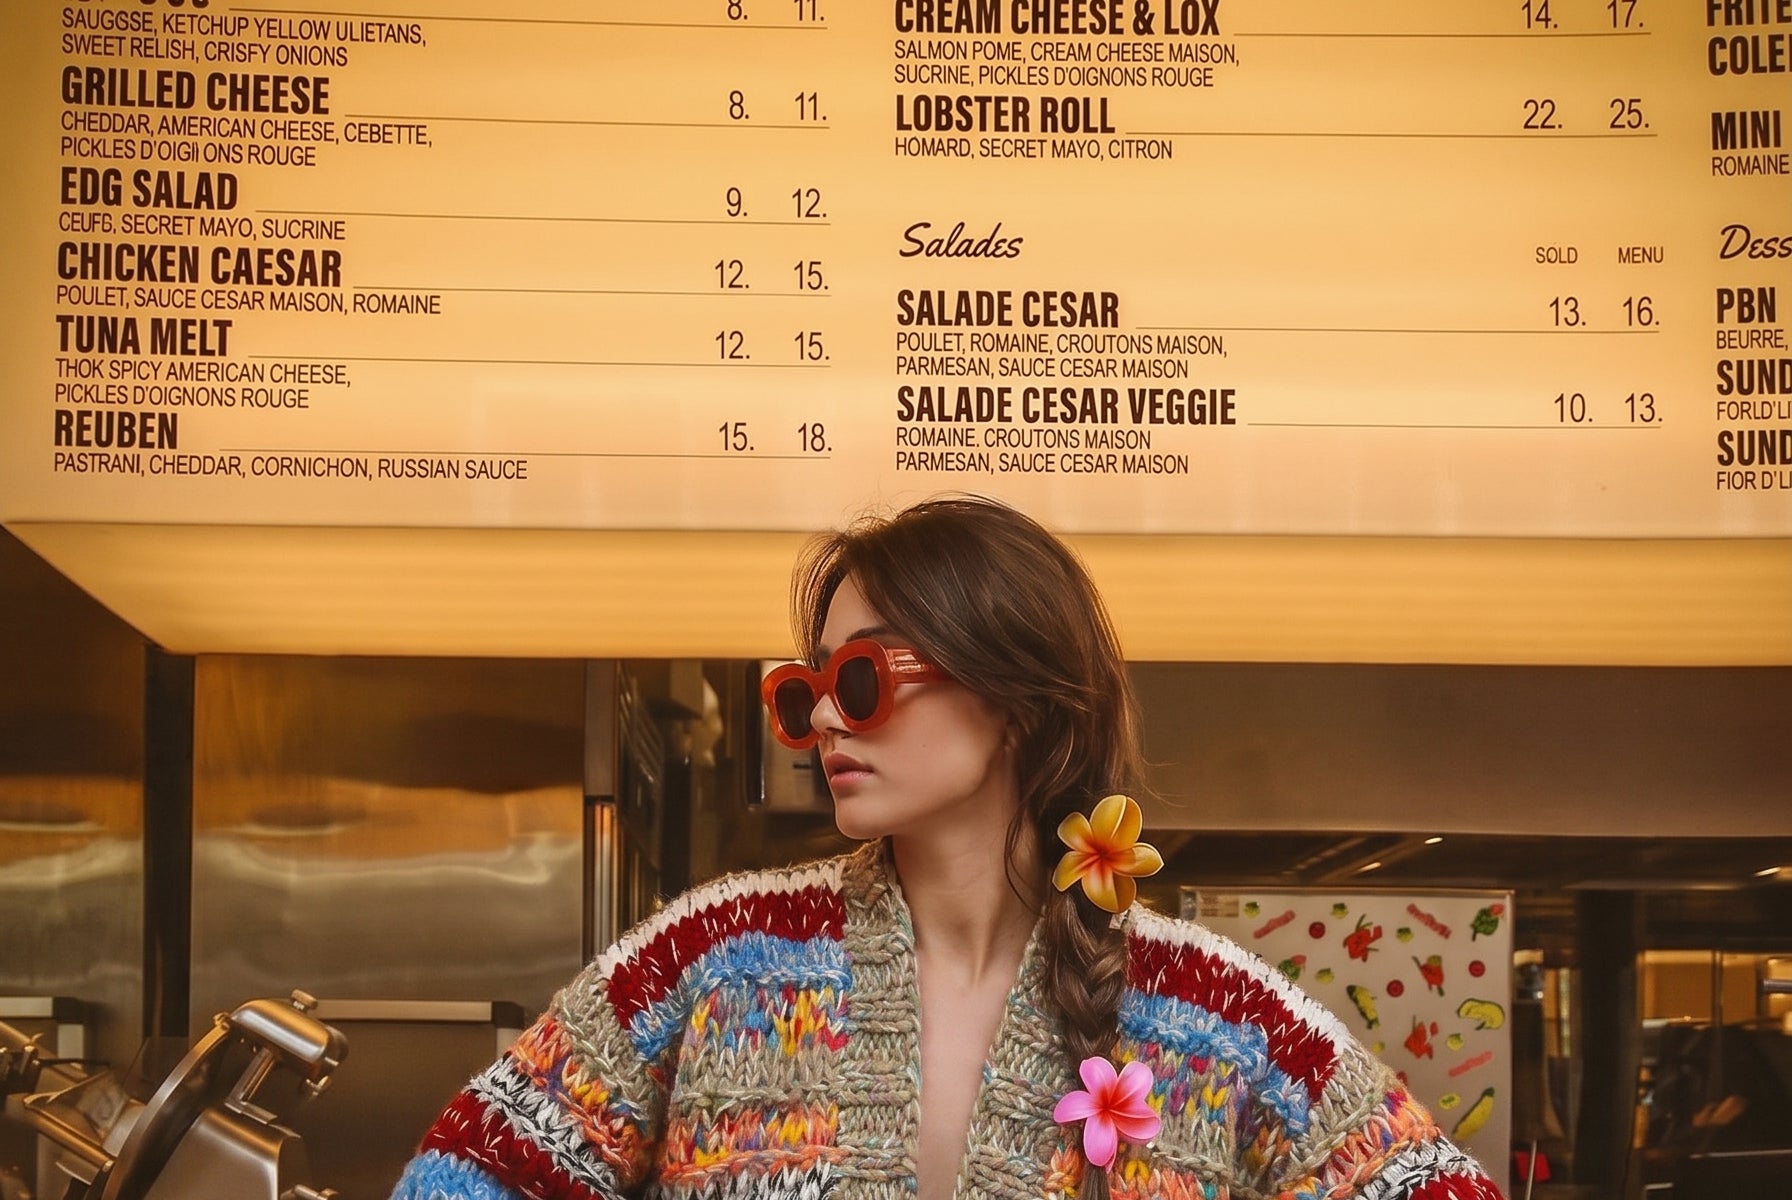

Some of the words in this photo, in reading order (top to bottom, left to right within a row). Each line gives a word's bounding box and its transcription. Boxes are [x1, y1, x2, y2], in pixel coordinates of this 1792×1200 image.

[895, 0, 1001, 34] CREAM
[1011, 0, 1124, 35] CHEESE
[1133, 0, 1155, 36] &
[1164, 0, 1220, 36] LOX
[1522, 0, 1557, 29] 14.
[1608, 0, 1643, 28] 17.
[163, 13, 249, 37] KETCHUP
[254, 18, 331, 40] YELLOW
[336, 21, 426, 47] ULIETANS,
[62, 33, 126, 56] SWEET
[131, 37, 199, 64] RELISH,
[276, 44, 347, 67] ONIONS
[895, 40, 967, 60] SALMON
[973, 41, 1026, 64] POME,
[1031, 42, 1091, 61] CREAM
[1097, 43, 1164, 62] CHEESE
[1169, 43, 1239, 66] MAISON,
[1708, 34, 1792, 75] COLE
[62, 66, 195, 109] GRILLED
[207, 72, 329, 115] CHEESE
[895, 64, 973, 86] SUCRINE,
[979, 65, 1049, 85] PICKLES
[1054, 67, 1147, 86] D'OIGNONS
[1152, 67, 1213, 87] ROUGE
[730, 91, 749, 119] 8.
[795, 92, 826, 120] 11.
[897, 95, 1030, 132] LOBSTER
[1041, 97, 1115, 133] ROLL
[1524, 99, 1562, 129] 22.
[1610, 99, 1649, 129] 25.
[61, 110, 154, 137] CHEDDAR,
[157, 115, 255, 138] AMERICAN
[261, 119, 339, 144] CHEESE,
[344, 122, 431, 147] CEBETTE,
[1712, 110, 1781, 150] MINI
[62, 136, 136, 159] PICKLES
[248, 144, 316, 166] ROUGE
[980, 138, 1047, 158] SECRET
[1052, 140, 1103, 161] MAYO,
[1109, 139, 1172, 159] CITRON
[1712, 154, 1790, 176] ROMAINE
[61, 167, 122, 206] EDG
[133, 169, 237, 210] SALAD
[727, 187, 747, 217] 9.
[793, 189, 826, 218] 12.
[121, 214, 195, 235] SECRET
[200, 217, 256, 241] MAYO,
[262, 219, 345, 240] SUCRINE
[899, 222, 1023, 258] Salades
[58, 242, 199, 283] CHICKEN
[211, 247, 341, 287] CAESAR
[1536, 247, 1577, 263] SOLD
[1619, 247, 1663, 263] MENU
[715, 260, 749, 288] 12.
[794, 261, 828, 290] 15.
[57, 285, 129, 309] POULET,
[134, 287, 196, 308] SAUCE
[201, 289, 264, 310] CESAR
[270, 292, 347, 315] MAISON,
[353, 294, 440, 314] ROMAINE
[897, 290, 1012, 326] SALADE
[1023, 291, 1118, 328] CESAR
[1550, 297, 1586, 326] 13.
[1623, 297, 1659, 326] 16.
[1717, 287, 1776, 323] PBN
[56, 315, 140, 355] TUNA
[151, 318, 232, 356] MELT
[716, 331, 749, 359] 12.
[795, 332, 829, 360] 15.
[897, 332, 965, 354] POULET,
[971, 333, 1052, 355] ROMAINE,
[1057, 334, 1152, 354] CROUTONS
[1157, 336, 1226, 357] MAISON,
[1717, 329, 1788, 351] BEURRE,
[55, 358, 104, 378] THOK
[109, 360, 162, 380] SPICY
[166, 362, 264, 382] AMERICAN
[270, 364, 350, 387] CHEESE,
[897, 356, 994, 379] PARMESAN,
[999, 358, 1055, 377] SAUCE
[1060, 358, 1118, 377] CESAR
[1123, 359, 1187, 378] MAISON
[56, 383, 128, 404] PICKLES
[133, 386, 236, 407] D'OIGNONS
[242, 388, 309, 408] ROUGE
[897, 386, 1012, 422] SALADE
[1023, 387, 1118, 424] CESAR
[1128, 388, 1236, 425] VEGGIE
[1555, 393, 1592, 422] 10.
[1625, 393, 1662, 422] 13.
[55, 409, 177, 449] REUBEN
[720, 422, 754, 451] 15.
[798, 423, 831, 452] 18.
[984, 428, 1080, 448] CROUTONS
[1085, 430, 1150, 449] MAISON
[55, 452, 144, 477] PASTRANI,
[150, 455, 245, 478] CHEDDAR,
[252, 456, 372, 481] CORNICHON,
[378, 459, 459, 478] RUSSIAN
[465, 460, 527, 479] SAUCE
[897, 452, 993, 475] PARMESAN,
[999, 453, 1055, 472] SAUCE
[1061, 454, 1117, 473] CESAR
[1123, 454, 1188, 474] MAISON
[1717, 471, 1756, 490] FIOR
